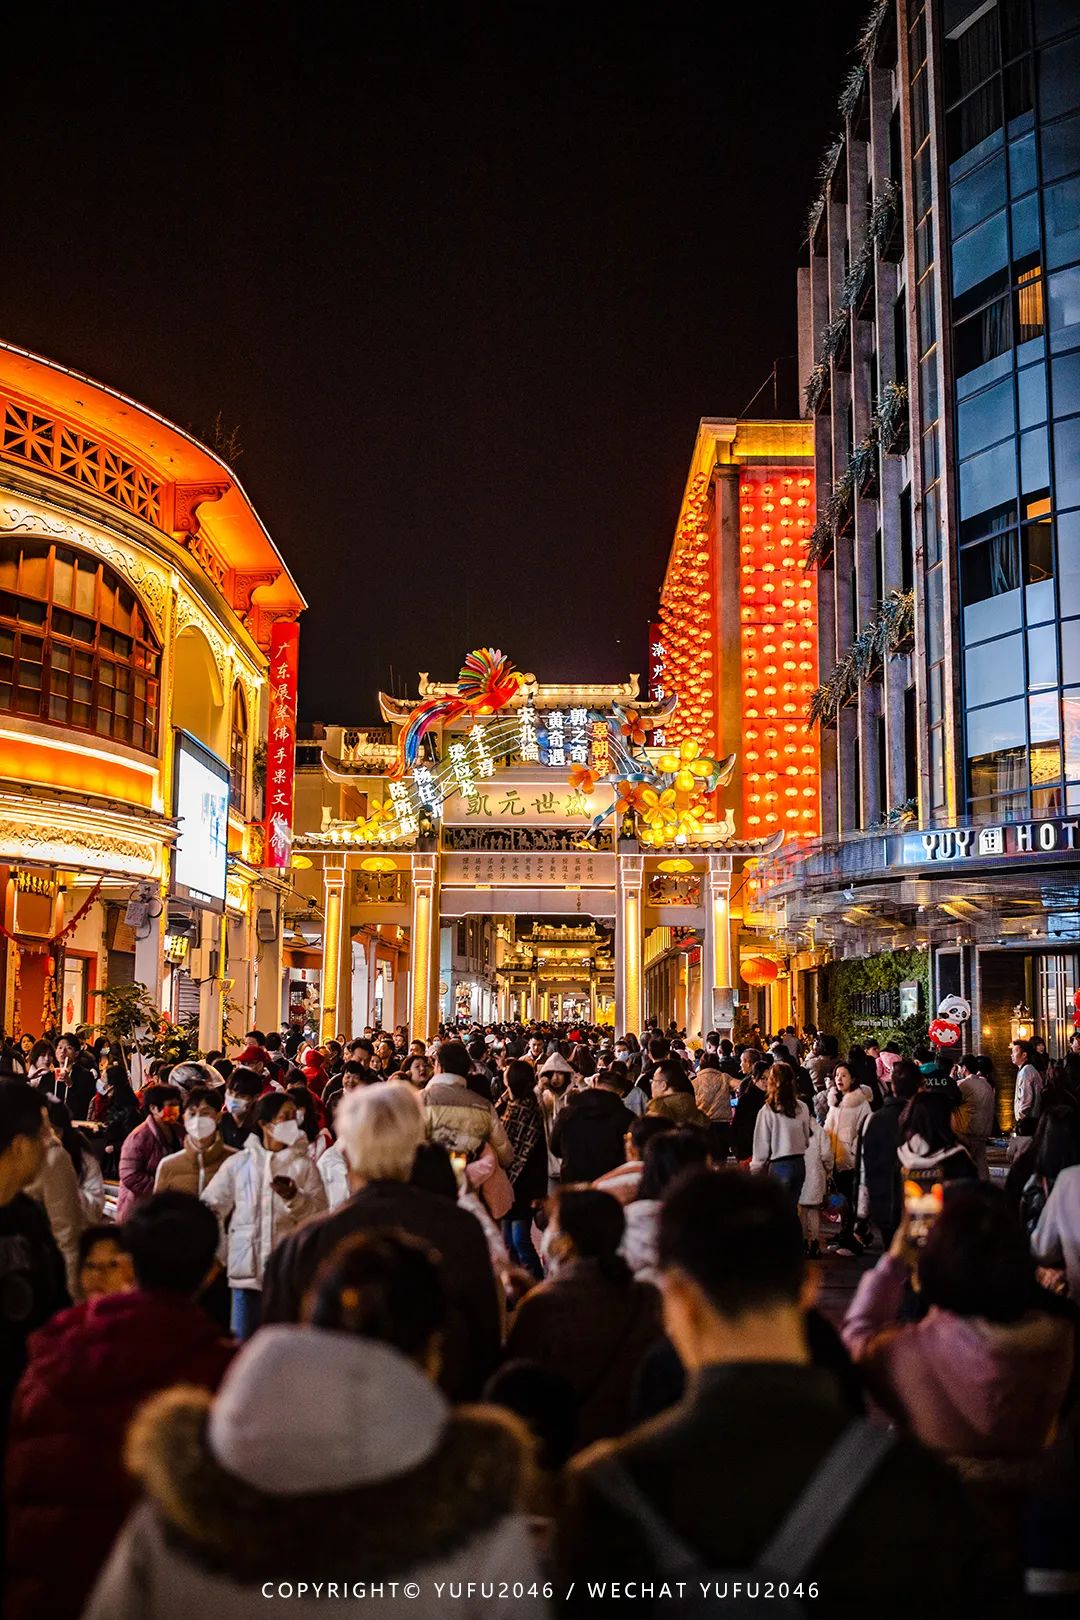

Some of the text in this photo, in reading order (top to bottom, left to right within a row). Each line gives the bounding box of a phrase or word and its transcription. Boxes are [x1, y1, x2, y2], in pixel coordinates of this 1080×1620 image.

[547, 711, 567, 766] 黄奇遇
[570, 708, 589, 762] 郭之奇
[922, 830, 974, 860] YUY
[1016, 820, 1079, 852] HOT
